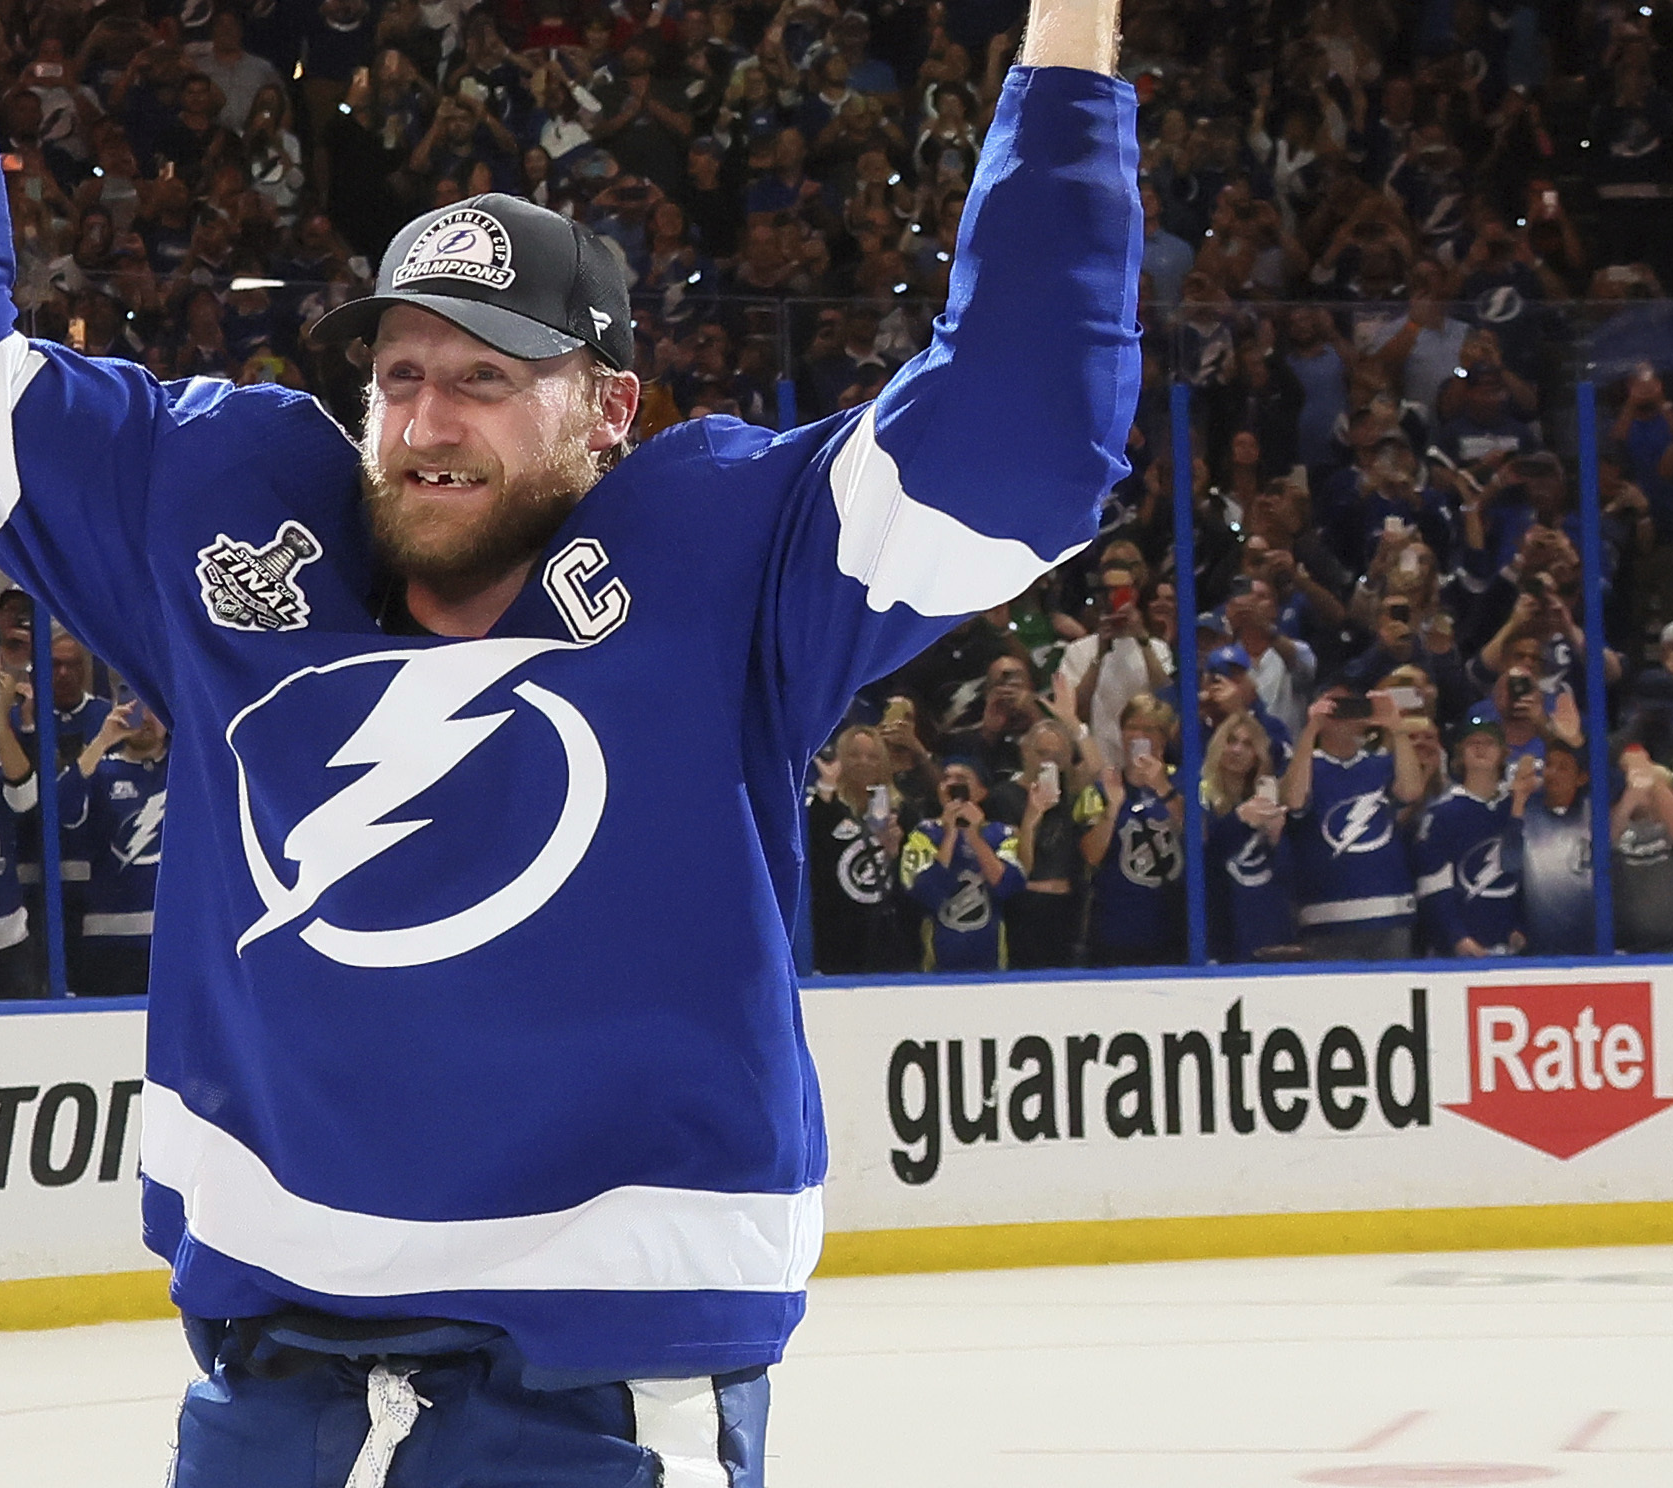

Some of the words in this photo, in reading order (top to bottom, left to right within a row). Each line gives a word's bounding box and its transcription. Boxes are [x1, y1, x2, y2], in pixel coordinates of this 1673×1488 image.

[396, 261, 508, 284] CHAMPIONS
[438, 212, 498, 233] STANLEY
[492, 235, 507, 262] CUP
[212, 548, 297, 623] FINAL
[236, 549, 277, 584] STANLEY
[274, 582, 296, 601] CUP
[544, 537, 632, 645] C
[889, 987, 1432, 1186] guaranteed
[1477, 1004, 1646, 1094] Rate
